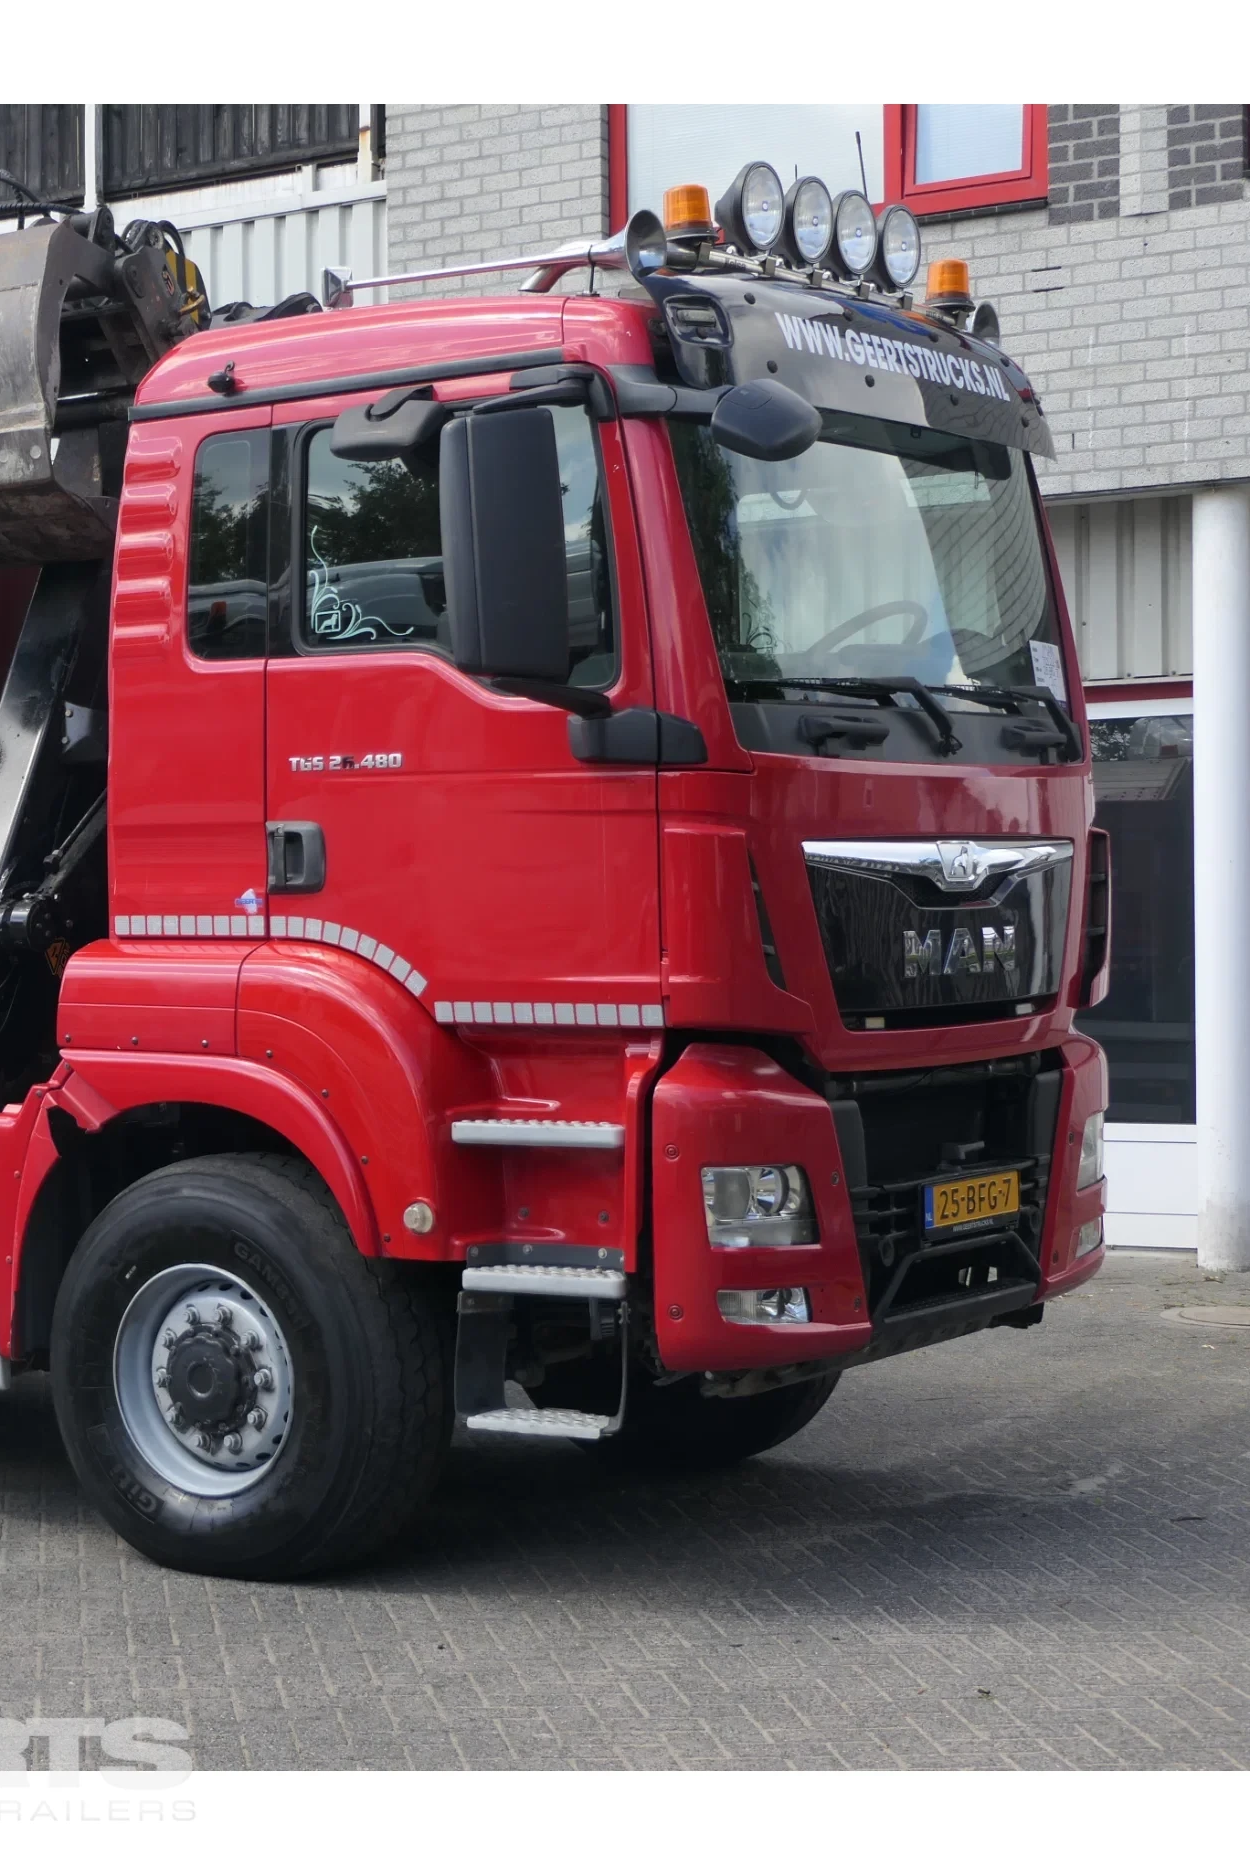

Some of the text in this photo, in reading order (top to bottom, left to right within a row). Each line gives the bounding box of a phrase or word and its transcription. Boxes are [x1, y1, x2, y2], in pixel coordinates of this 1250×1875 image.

[775, 312, 1010, 401] WWW.GEERTSTRUCKS.NL
[288, 757, 324, 772] TGS
[903, 926, 1015, 978] MAN
[939, 1177, 1012, 1220] 25-BFG-7
